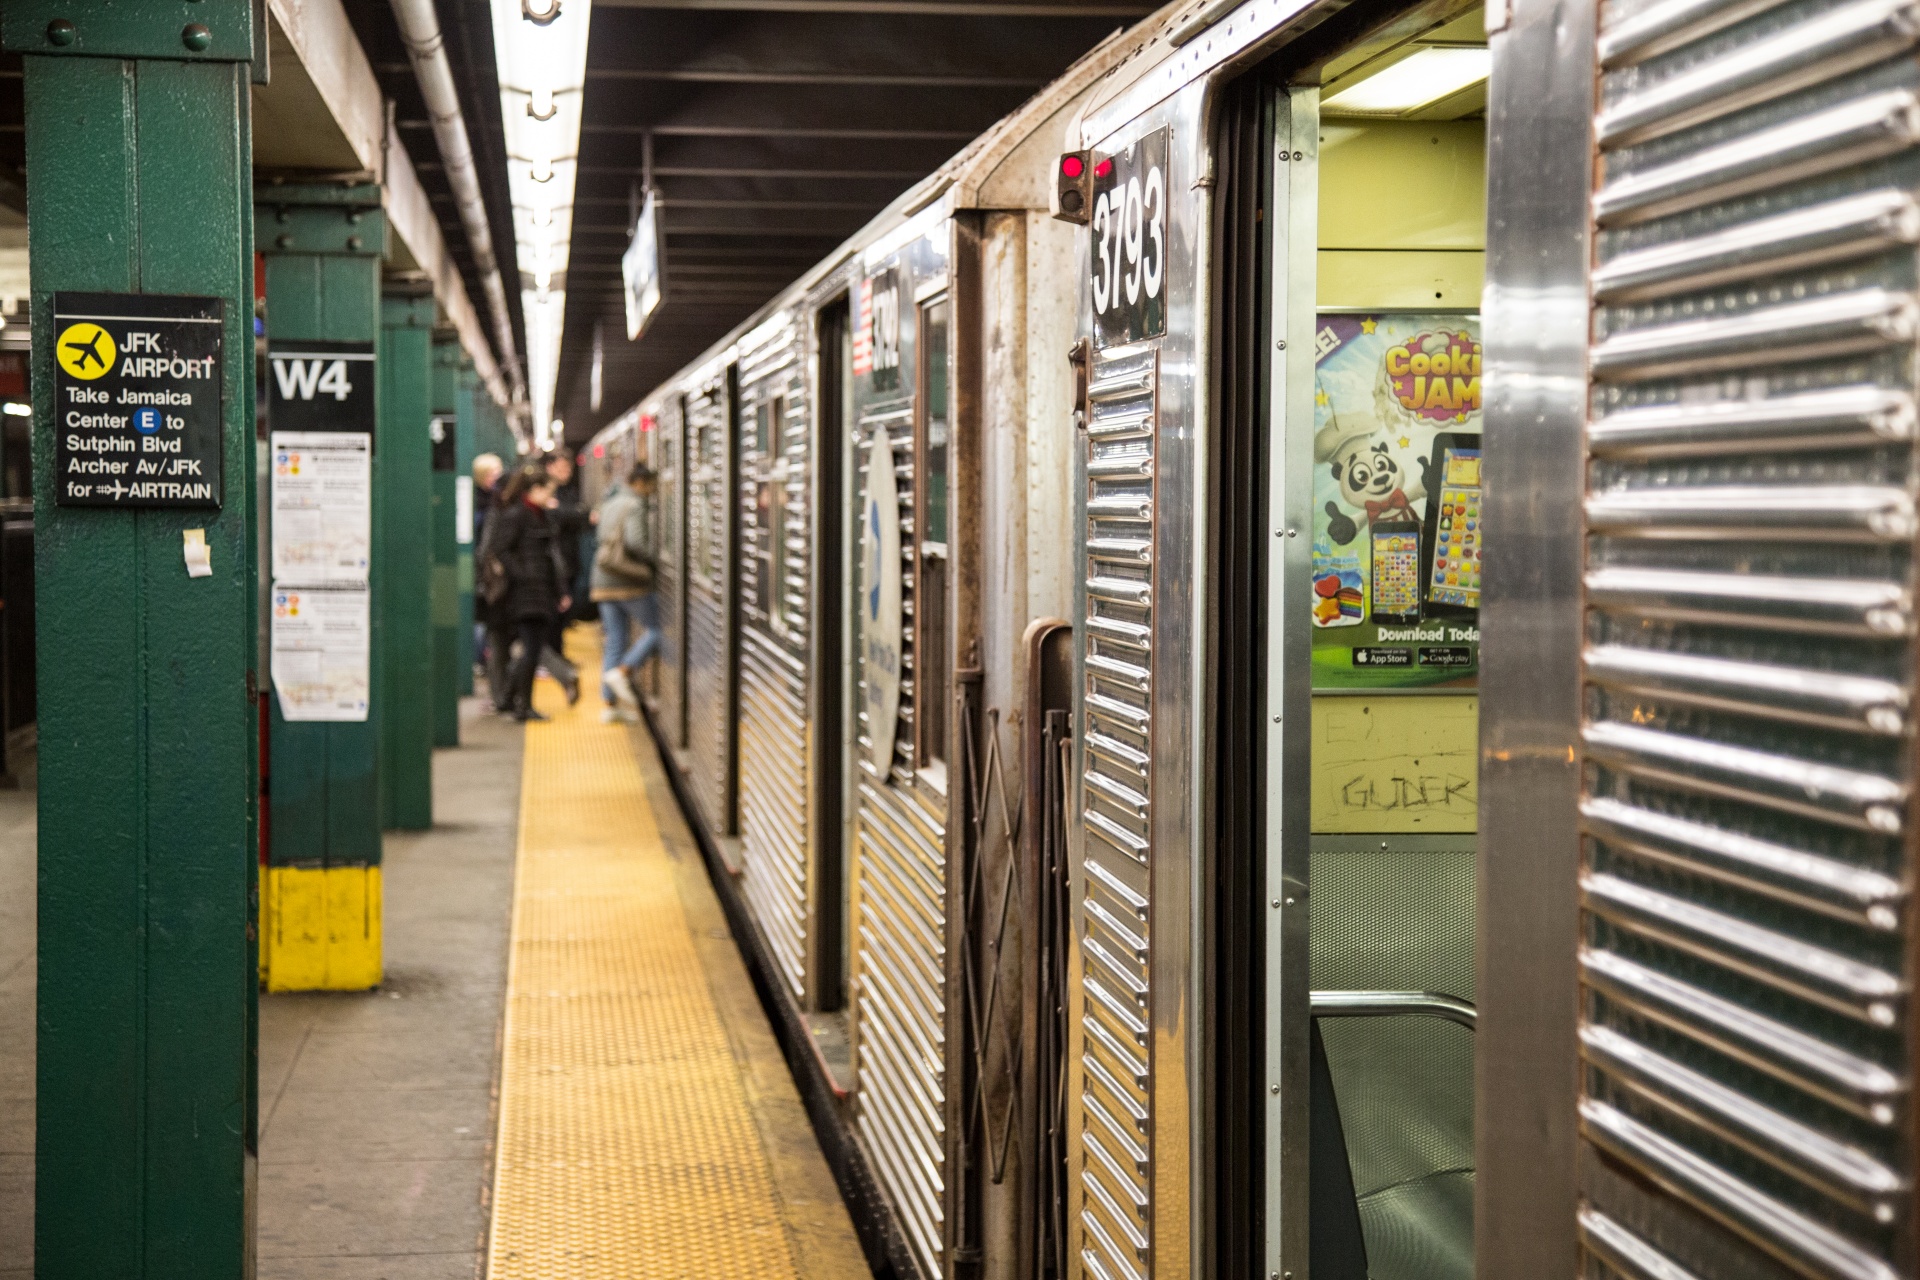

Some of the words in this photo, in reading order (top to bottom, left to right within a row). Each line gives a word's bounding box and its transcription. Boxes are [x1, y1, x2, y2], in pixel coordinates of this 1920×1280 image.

[1093, 166, 1163, 315] 3793
[120, 332, 162, 354] JFK
[120, 358, 215, 380] AIRPORT
[1386, 344, 1482, 377] Cooki
[273, 360, 353, 401] W4
[66, 387, 110, 404] Take
[116, 388, 192, 406] Jamaica
[1399, 376, 1482, 410] JAM
[66, 411, 128, 429] Center
[141, 411, 154, 428] E
[165, 414, 185, 431] to
[66, 435, 135, 454] Sutphin
[142, 436, 181, 453] Blvd
[67, 458, 128, 475] Archer
[135, 458, 202, 477] Av/JFK
[67, 482, 92, 498] for
[128, 483, 211, 500] AIRTRAIN
[1378, 627, 1444, 642] Download
[1448, 627, 1480, 642] Toda
[1370, 655, 1387, 665] App
[1387, 654, 1408, 663] Store
[1429, 654, 1454, 665] Google
[1454, 654, 1469, 664] play
